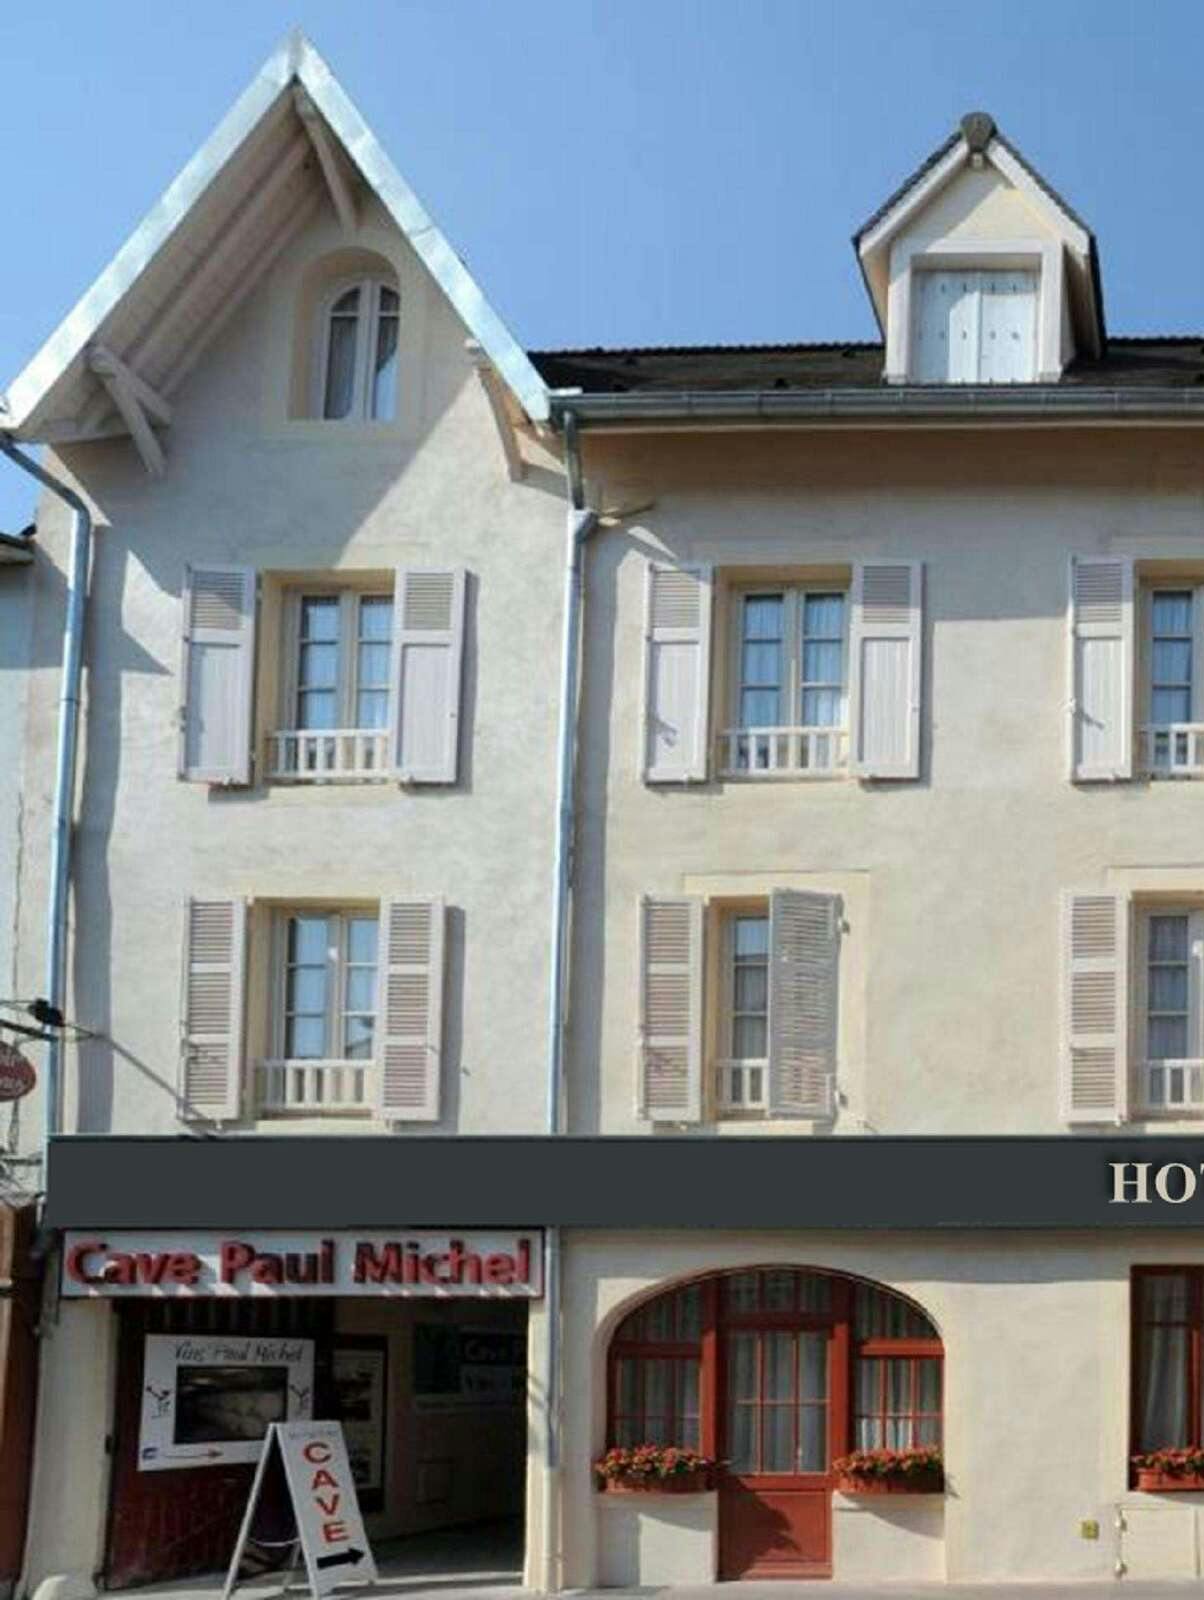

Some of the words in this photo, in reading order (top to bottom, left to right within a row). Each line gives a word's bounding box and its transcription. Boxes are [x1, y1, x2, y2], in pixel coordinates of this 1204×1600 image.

[66, 1240, 201, 1285] Cave
[220, 1239, 336, 1285] Paul
[353, 1238, 532, 1285] Michel
[303, 1441, 350, 1543] CAVE
